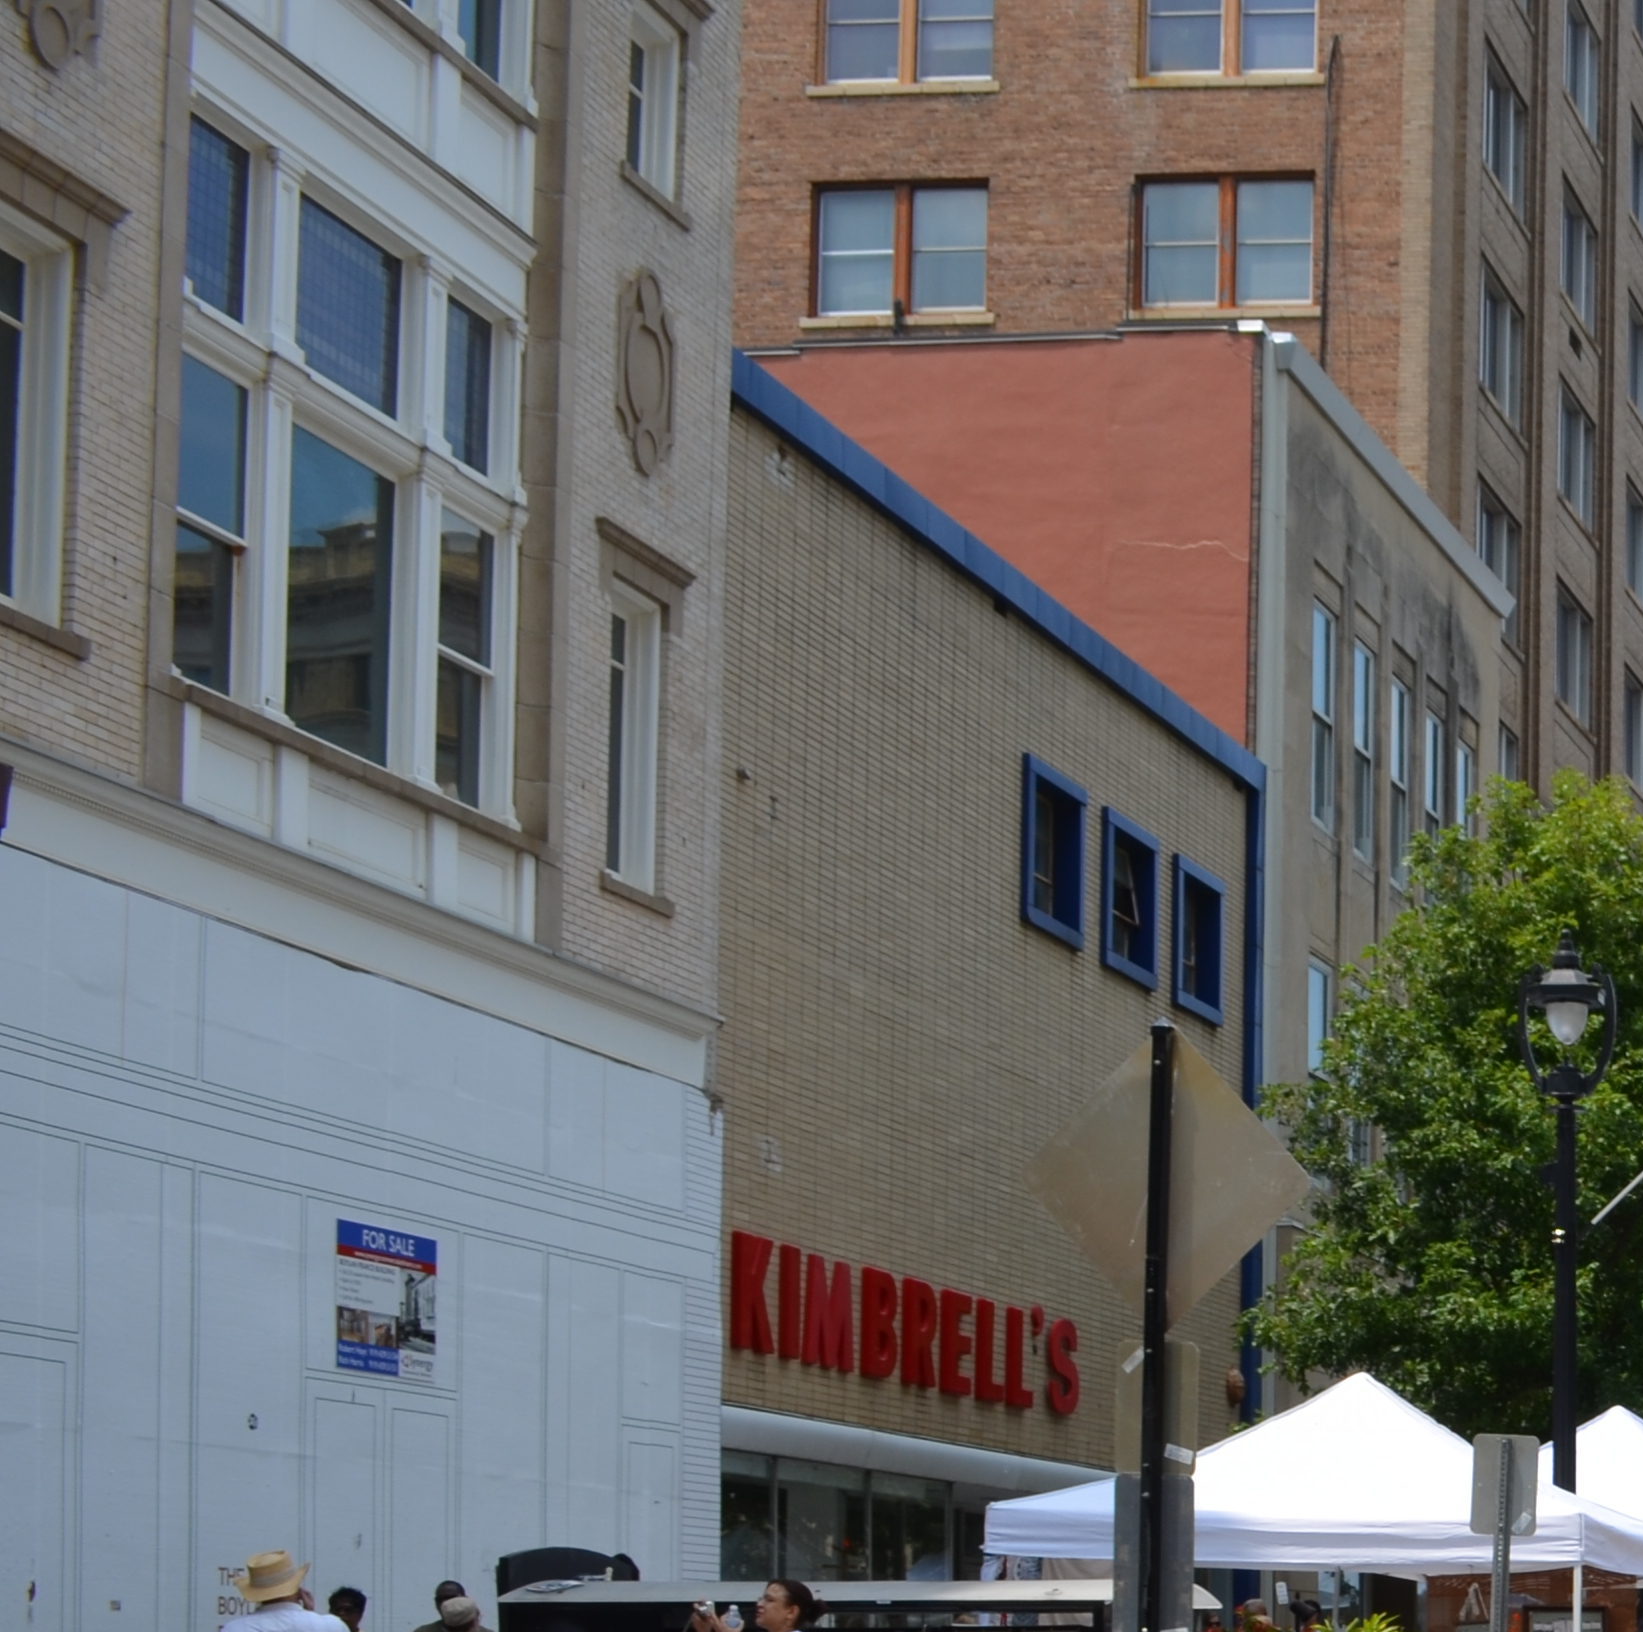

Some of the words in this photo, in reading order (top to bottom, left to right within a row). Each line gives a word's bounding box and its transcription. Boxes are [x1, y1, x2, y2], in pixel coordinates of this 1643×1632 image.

[362, 1229, 386, 1251] FOR
[388, 1235, 415, 1257] SALE
[730, 1230, 1080, 1416] KIMBRELL'S
[218, 1596, 256, 1615] BOYL
